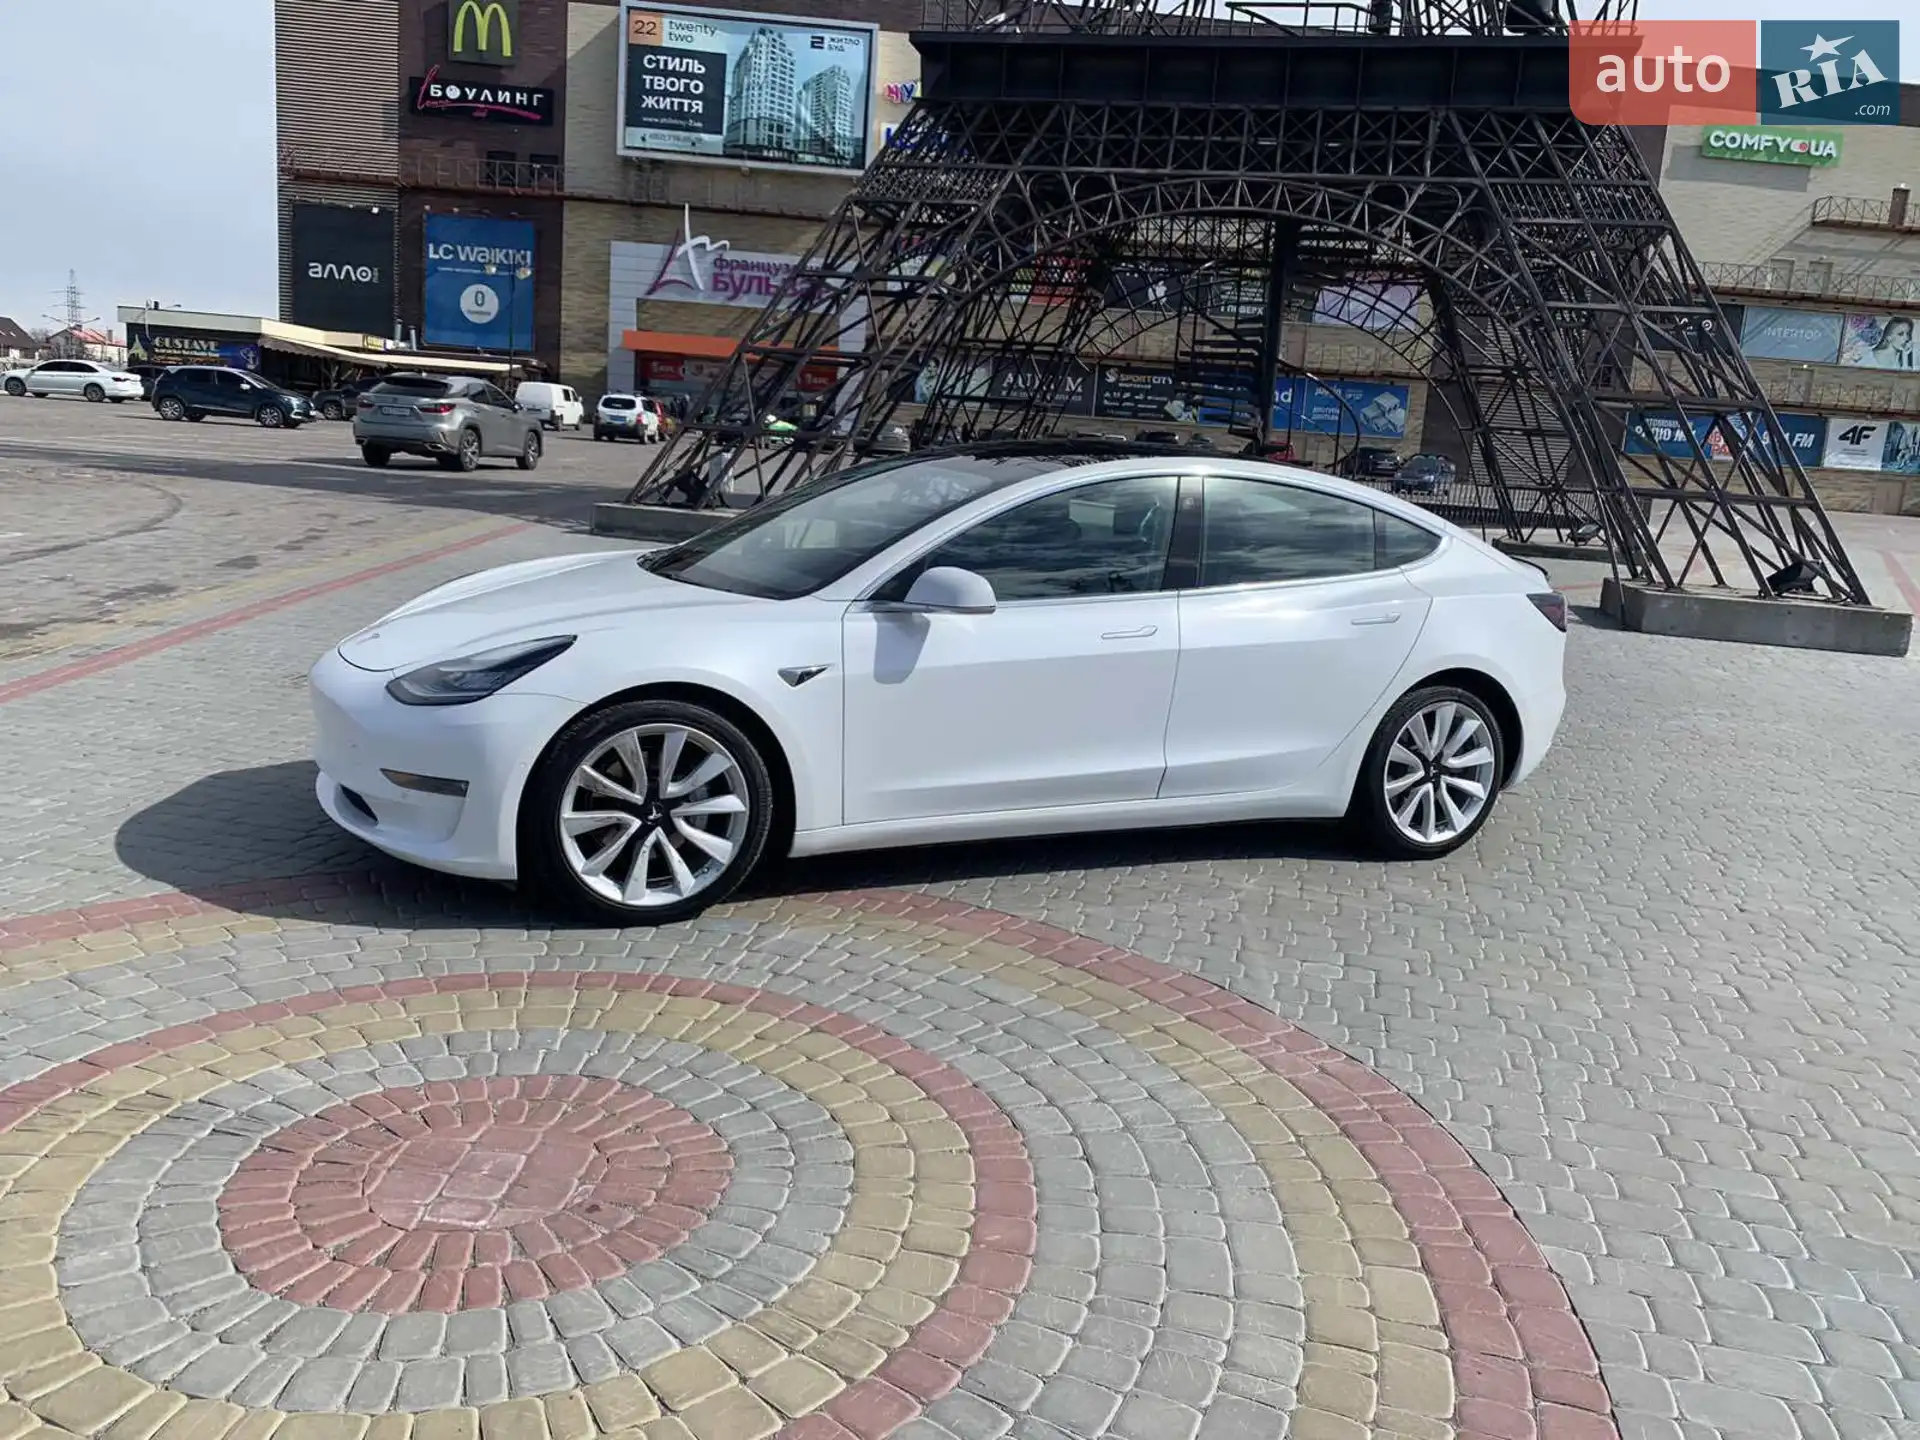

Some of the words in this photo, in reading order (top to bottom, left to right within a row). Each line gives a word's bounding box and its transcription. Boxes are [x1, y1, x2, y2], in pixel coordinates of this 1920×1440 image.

[633, 20, 657, 35] 22
[668, 20, 717, 36] twenty
[668, 32, 694, 43] two
[643, 54, 706, 74] СТИЛЬ
[642, 74, 704, 95] ТВОГО
[429, 84, 544, 106] БОУЛИНГ
[641, 95, 703, 114] ЖИТТЯ
[428, 243, 453, 260] LC
[474, 290, 485, 307] 0
[1763, 326, 1822, 340] INTERTOP
[1838, 425, 1878, 446] 4F
